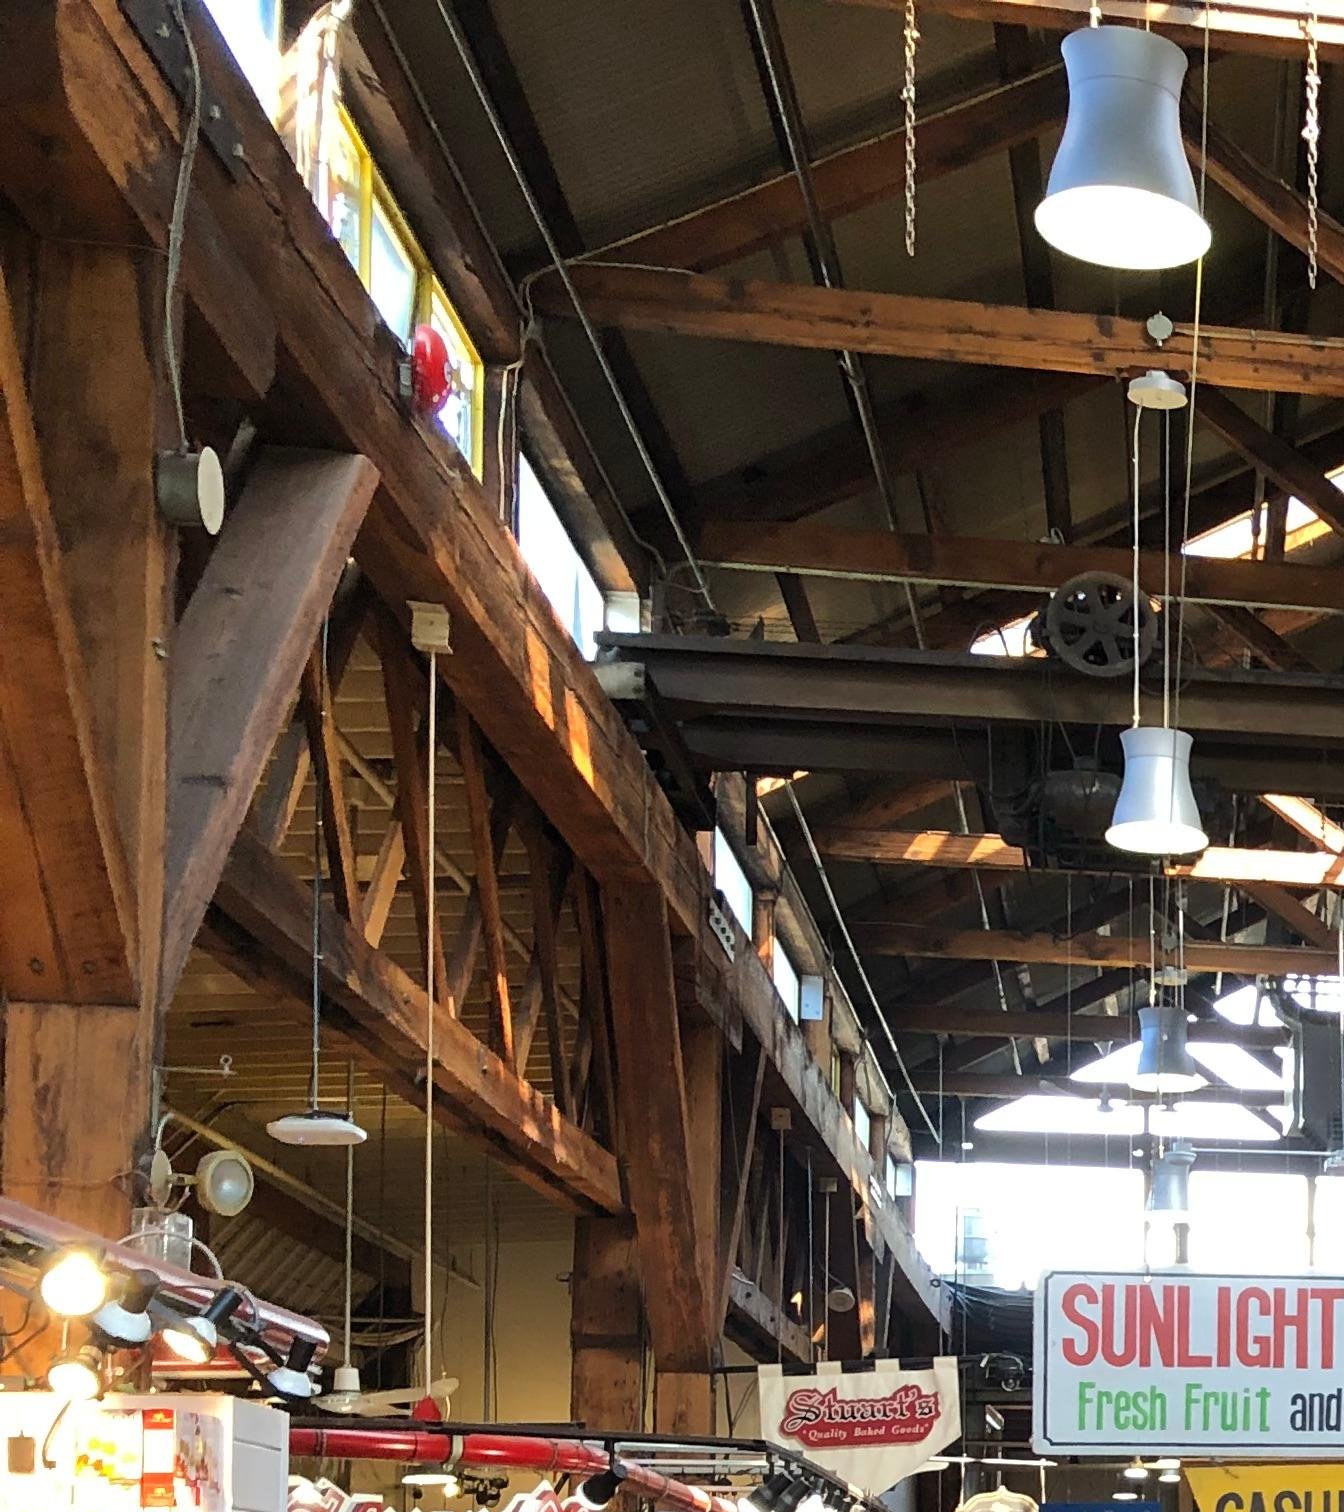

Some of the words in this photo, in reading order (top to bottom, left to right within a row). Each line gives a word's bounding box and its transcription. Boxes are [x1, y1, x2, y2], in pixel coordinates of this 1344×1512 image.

[783, 1387, 939, 1432] Stuart's
[1077, 1381, 1168, 1432] Fresh
[1184, 1382, 1272, 1432] Fruit
[1290, 1387, 1343, 1432] and
